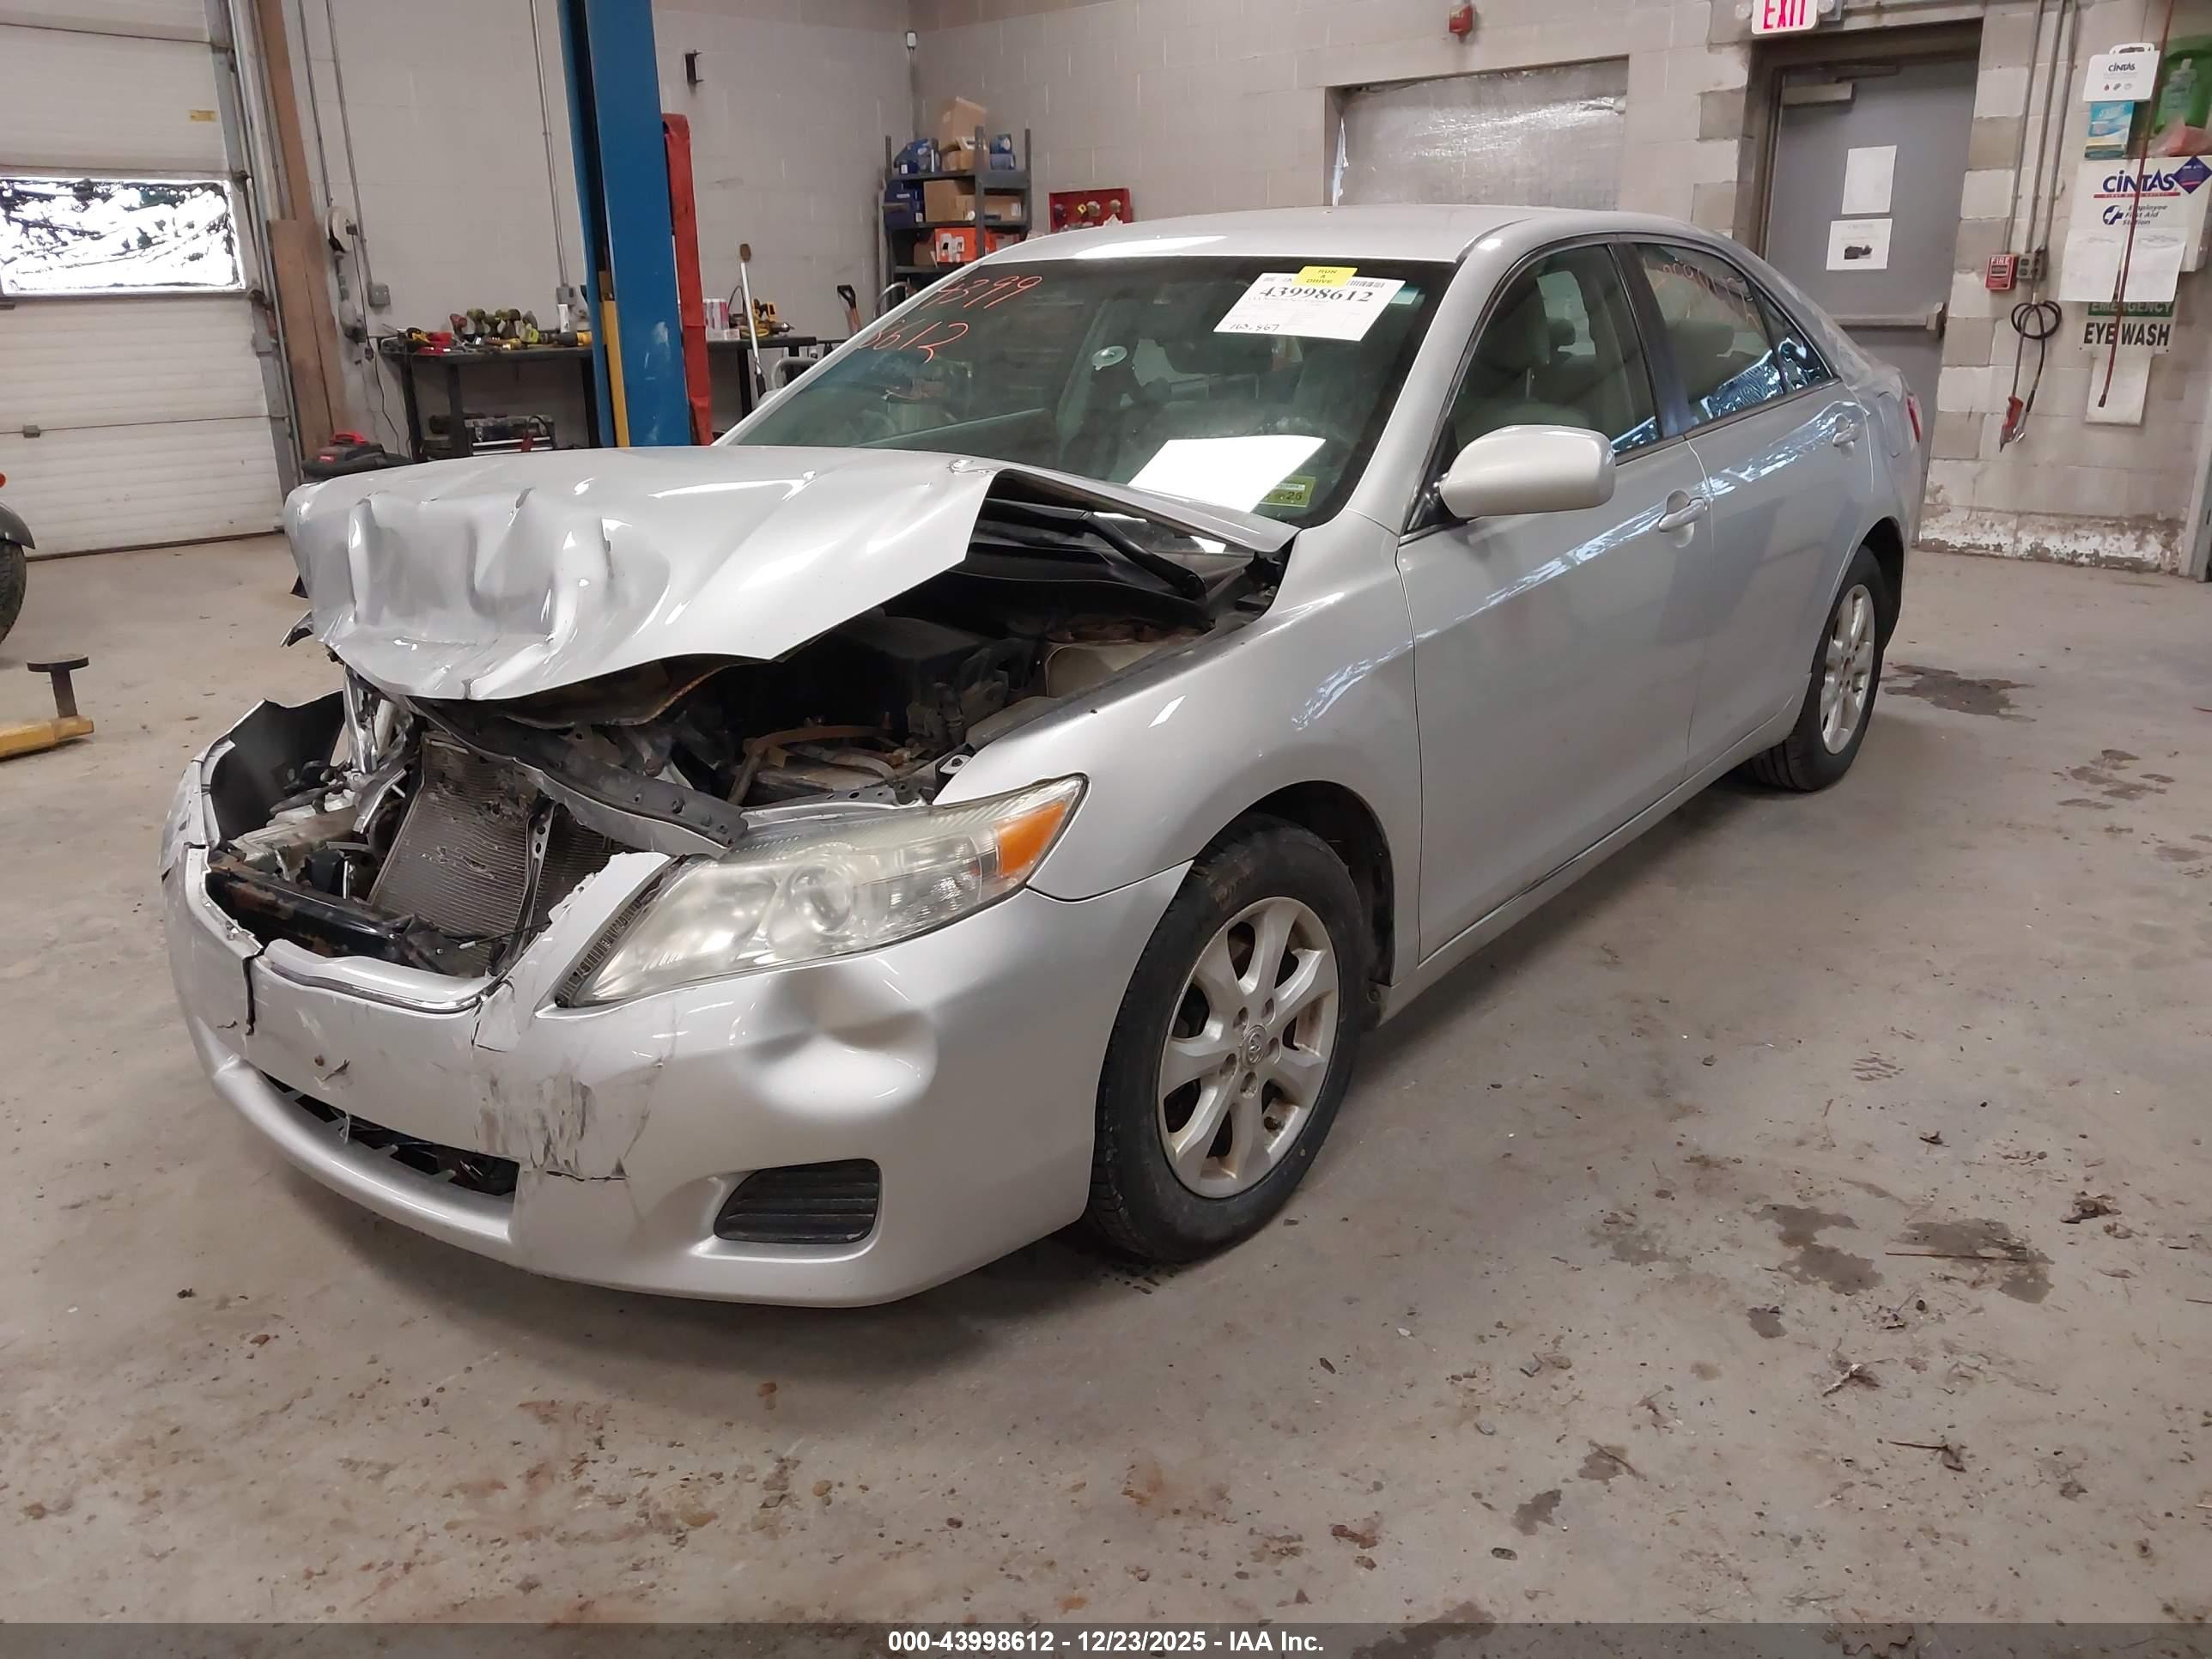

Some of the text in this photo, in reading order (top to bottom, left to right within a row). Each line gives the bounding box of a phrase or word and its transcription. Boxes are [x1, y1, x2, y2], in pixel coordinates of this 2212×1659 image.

[1763, 0, 1807, 29] EXIT
[1260, 287, 1373, 301] 43998612
[2084, 322, 2171, 346] EYE WASH
